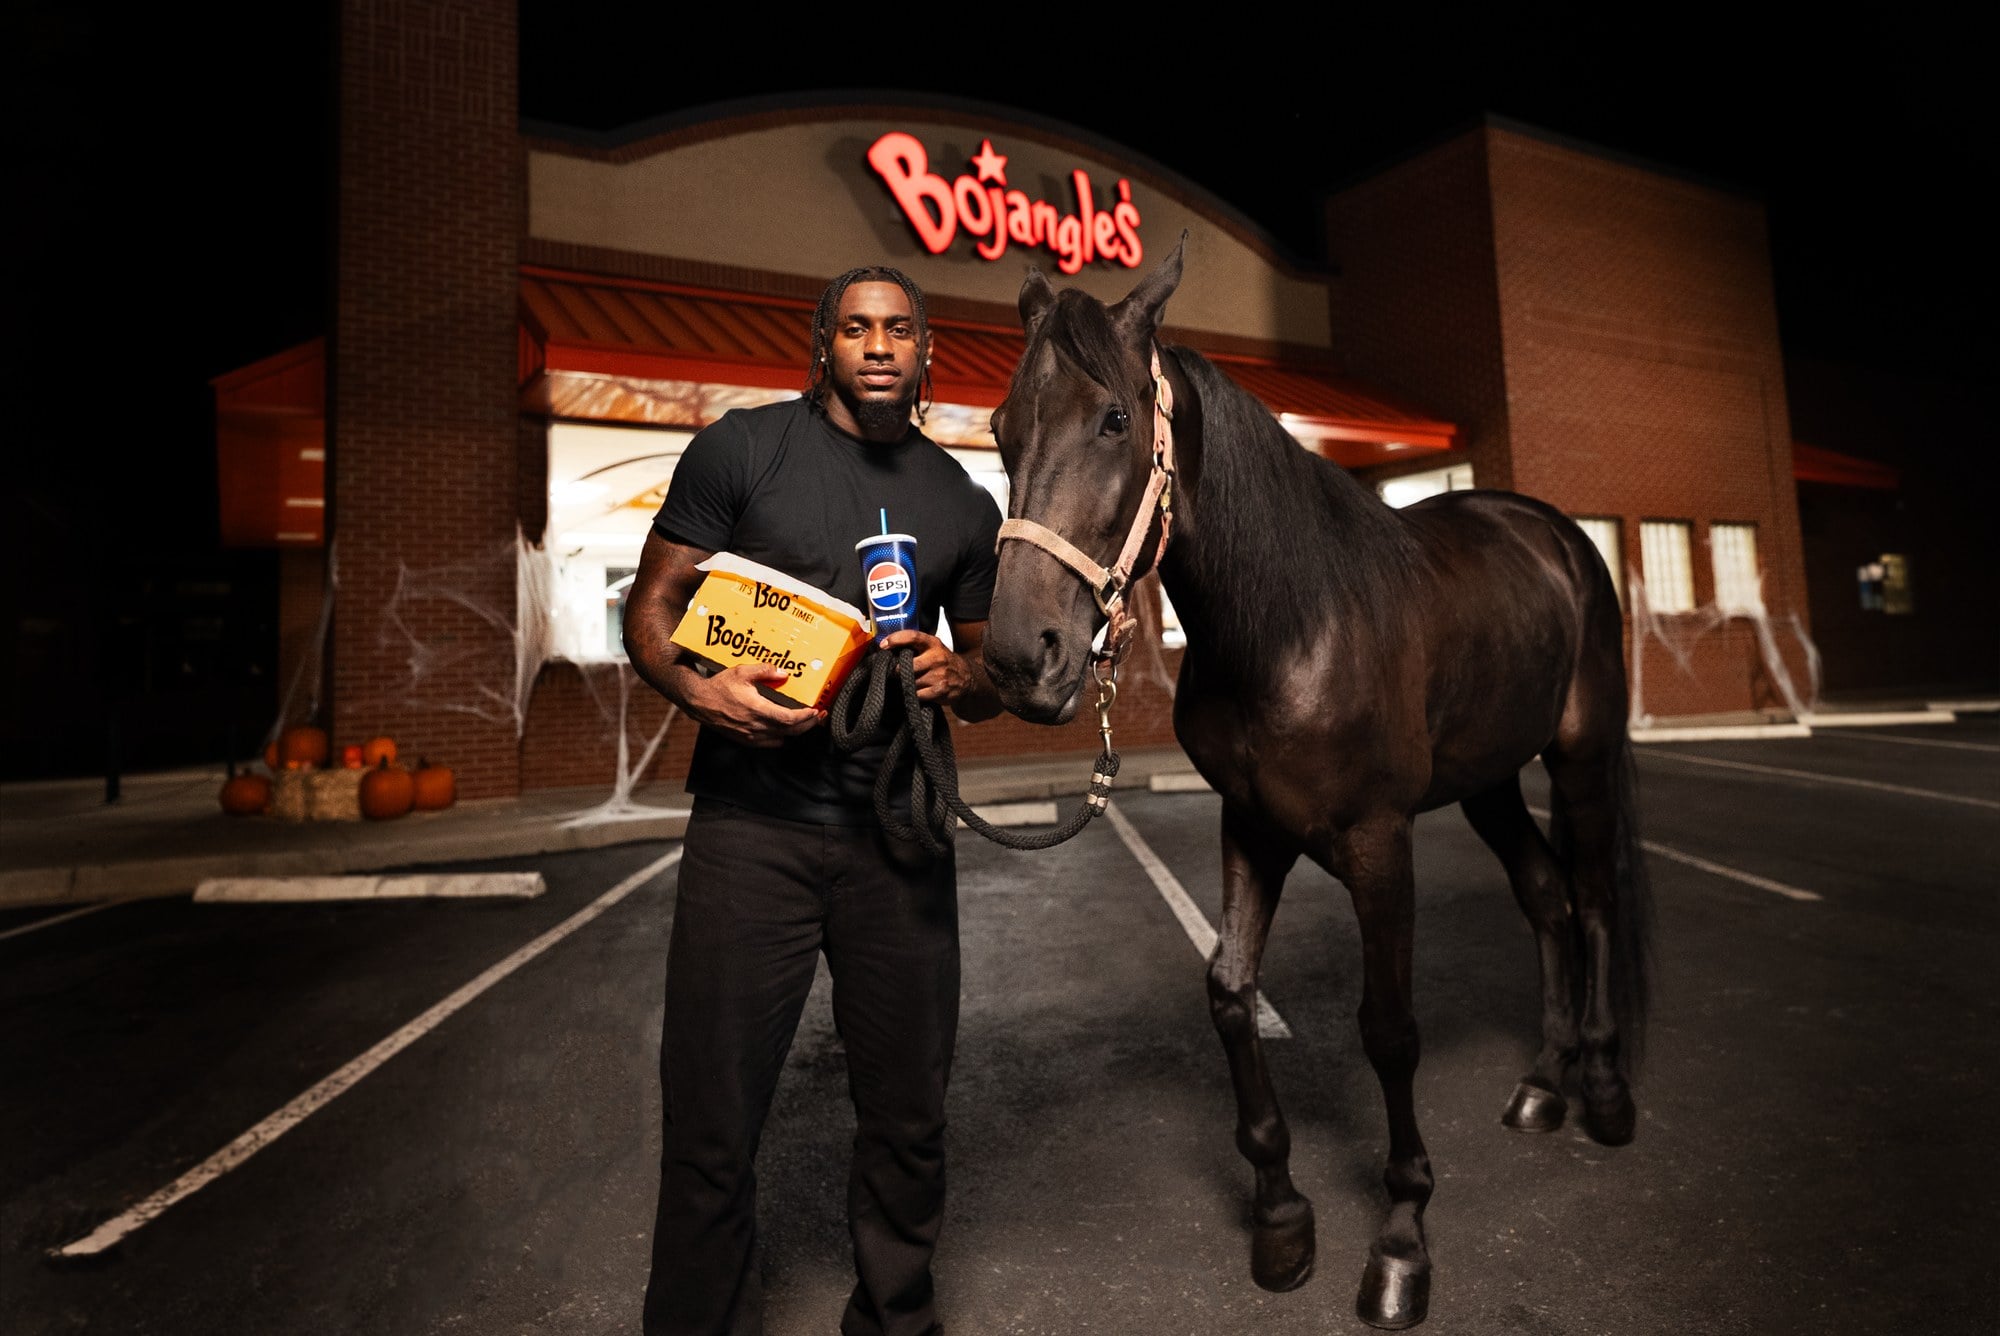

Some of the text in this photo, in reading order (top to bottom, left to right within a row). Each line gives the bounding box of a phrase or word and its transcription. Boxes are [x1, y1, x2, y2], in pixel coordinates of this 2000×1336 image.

[869, 580, 907, 593] PEPSI
[739, 583, 753, 595] IT'S
[791, 606, 814, 624] TIME!
